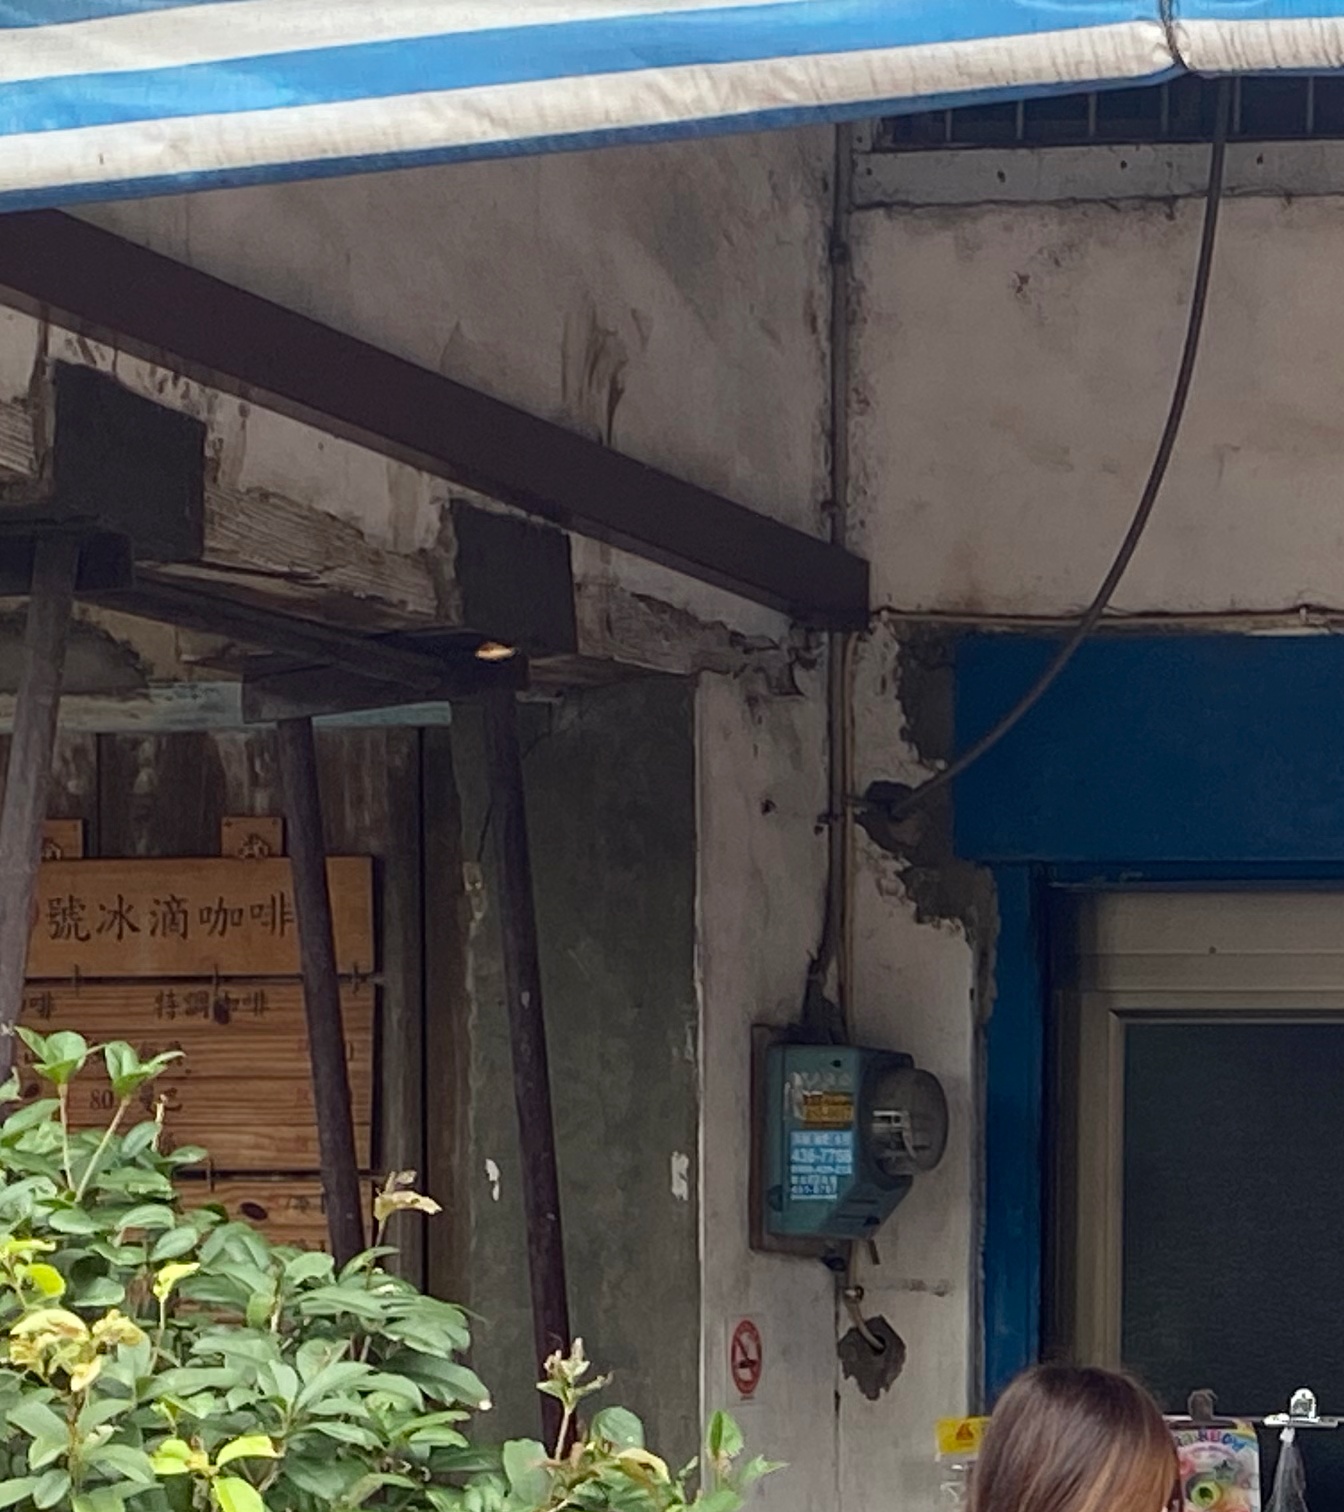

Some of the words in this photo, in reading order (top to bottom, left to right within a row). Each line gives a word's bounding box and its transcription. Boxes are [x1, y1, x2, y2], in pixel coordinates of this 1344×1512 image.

[46, 890, 295, 942] 號冰滴咖啡
